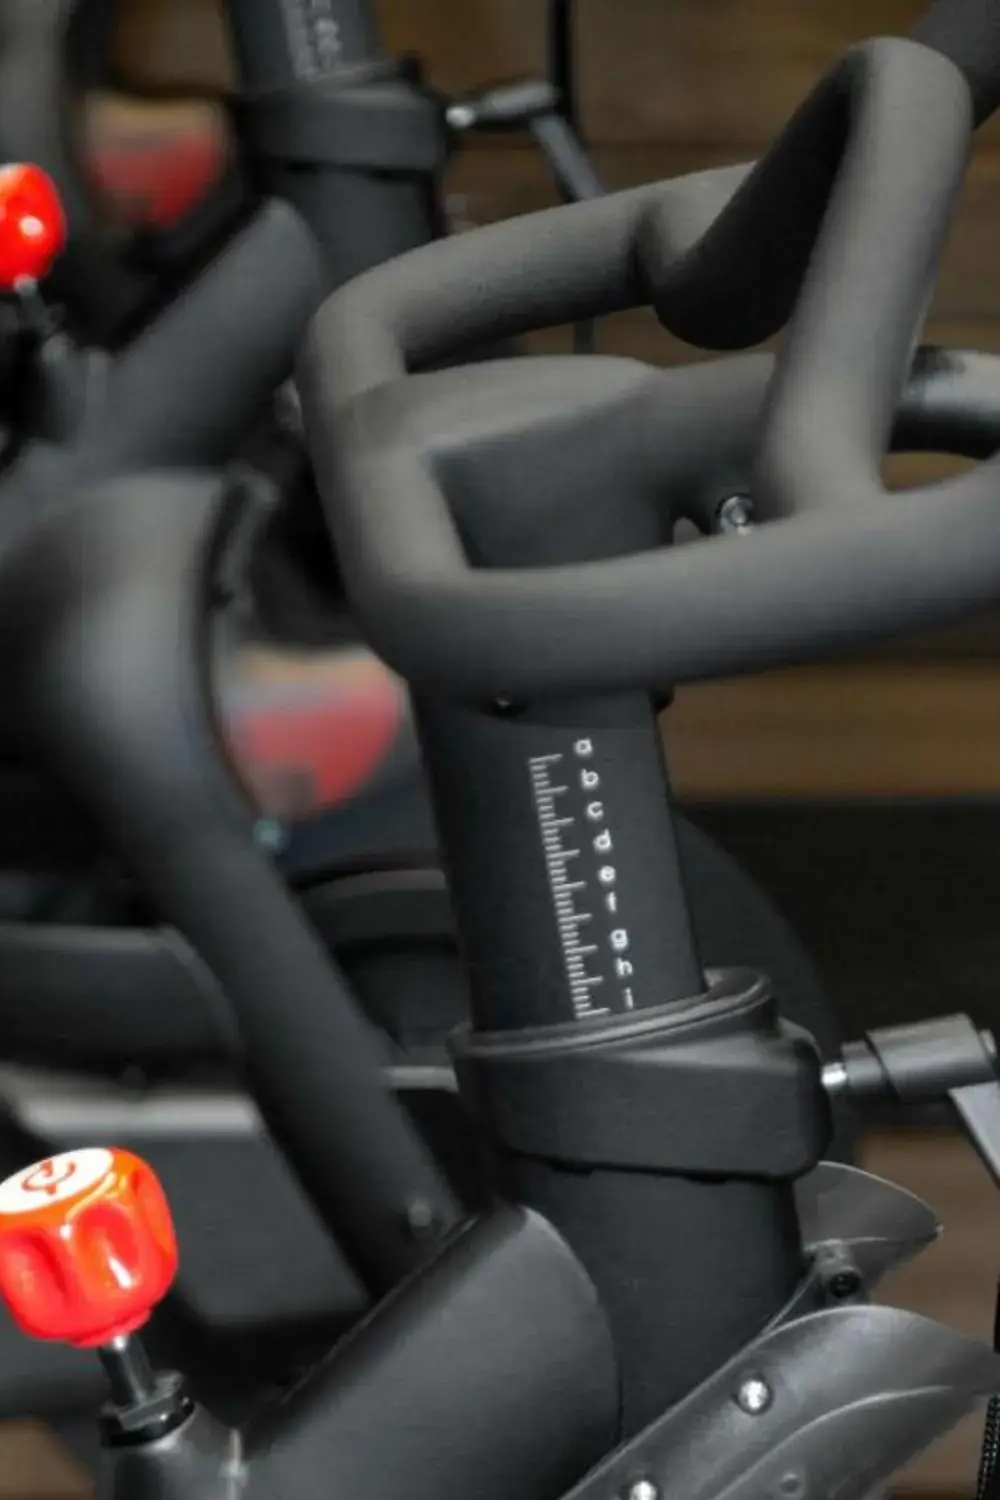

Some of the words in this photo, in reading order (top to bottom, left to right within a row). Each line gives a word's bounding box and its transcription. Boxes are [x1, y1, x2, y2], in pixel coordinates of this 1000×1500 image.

[580, 768, 600, 790] b
[586, 800, 605, 821] c
[592, 828, 614, 853] d
